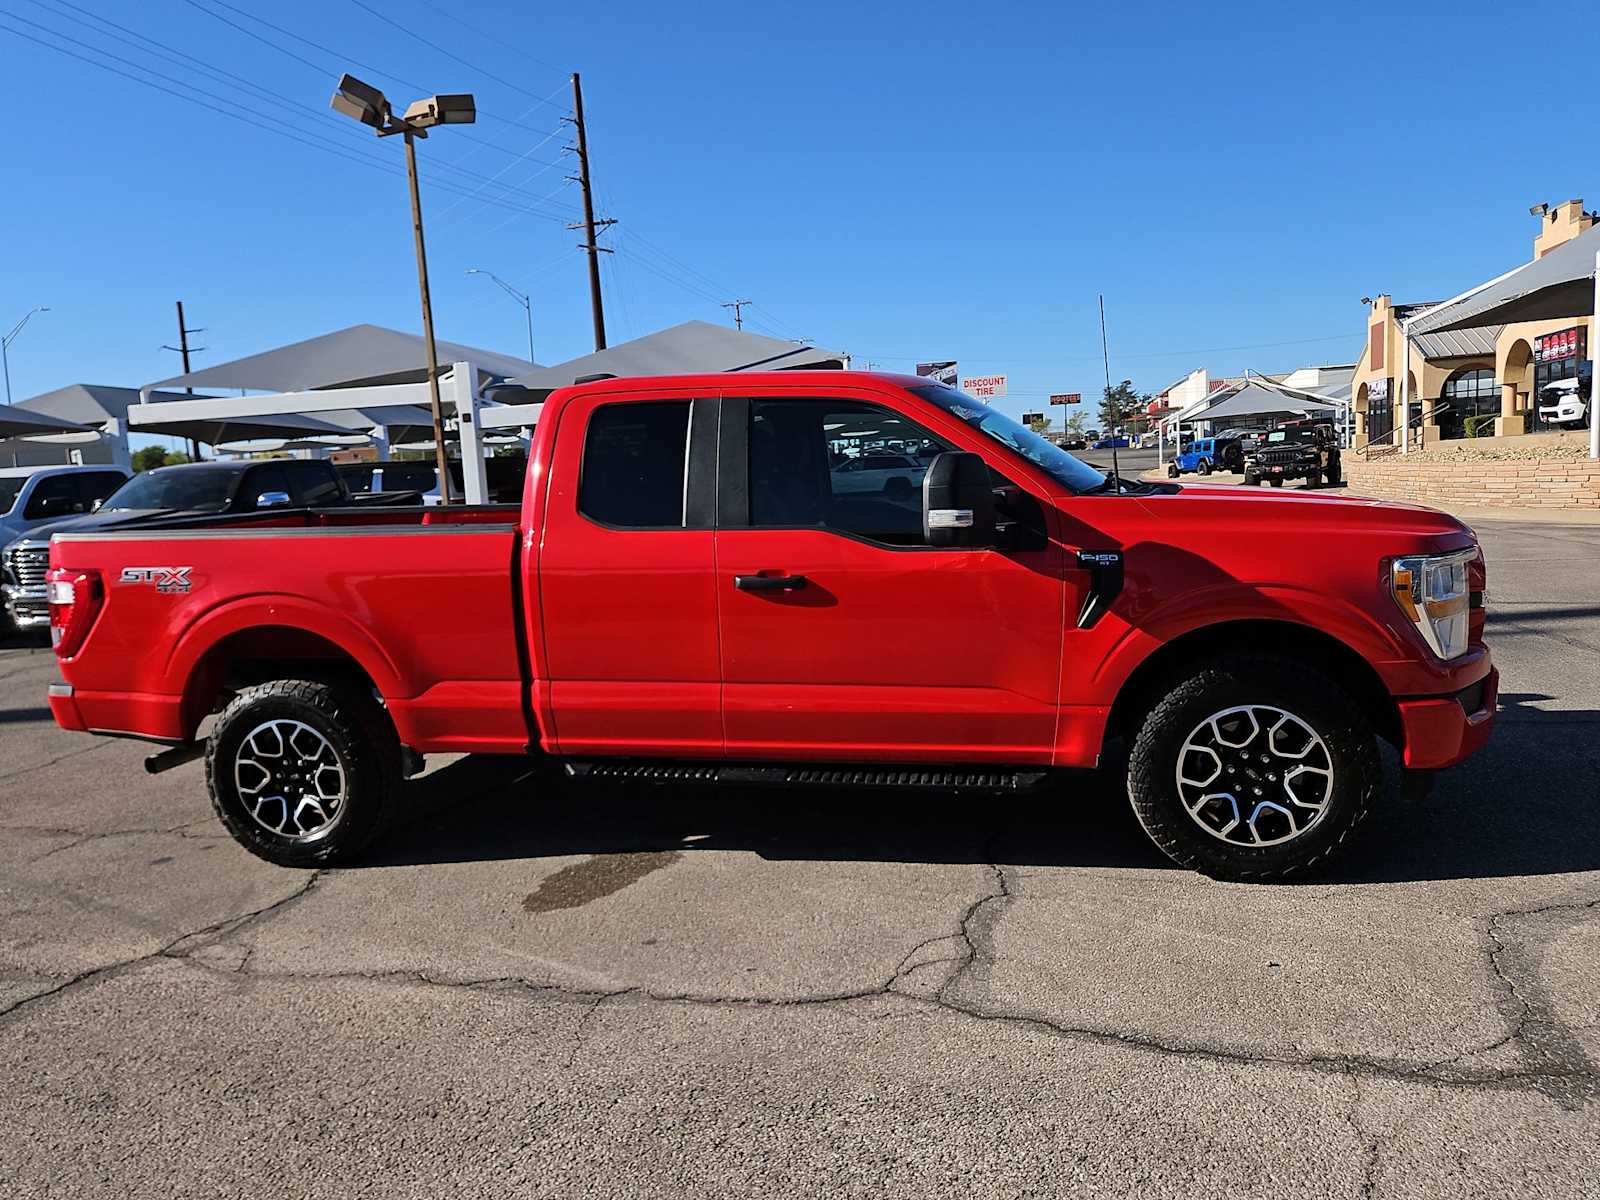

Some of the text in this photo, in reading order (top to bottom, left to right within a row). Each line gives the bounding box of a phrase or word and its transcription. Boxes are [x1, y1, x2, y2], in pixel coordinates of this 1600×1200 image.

[963, 377, 1006, 388] DISCOUNT
[975, 387, 995, 396] TIRE
[120, 566, 193, 586] STX
